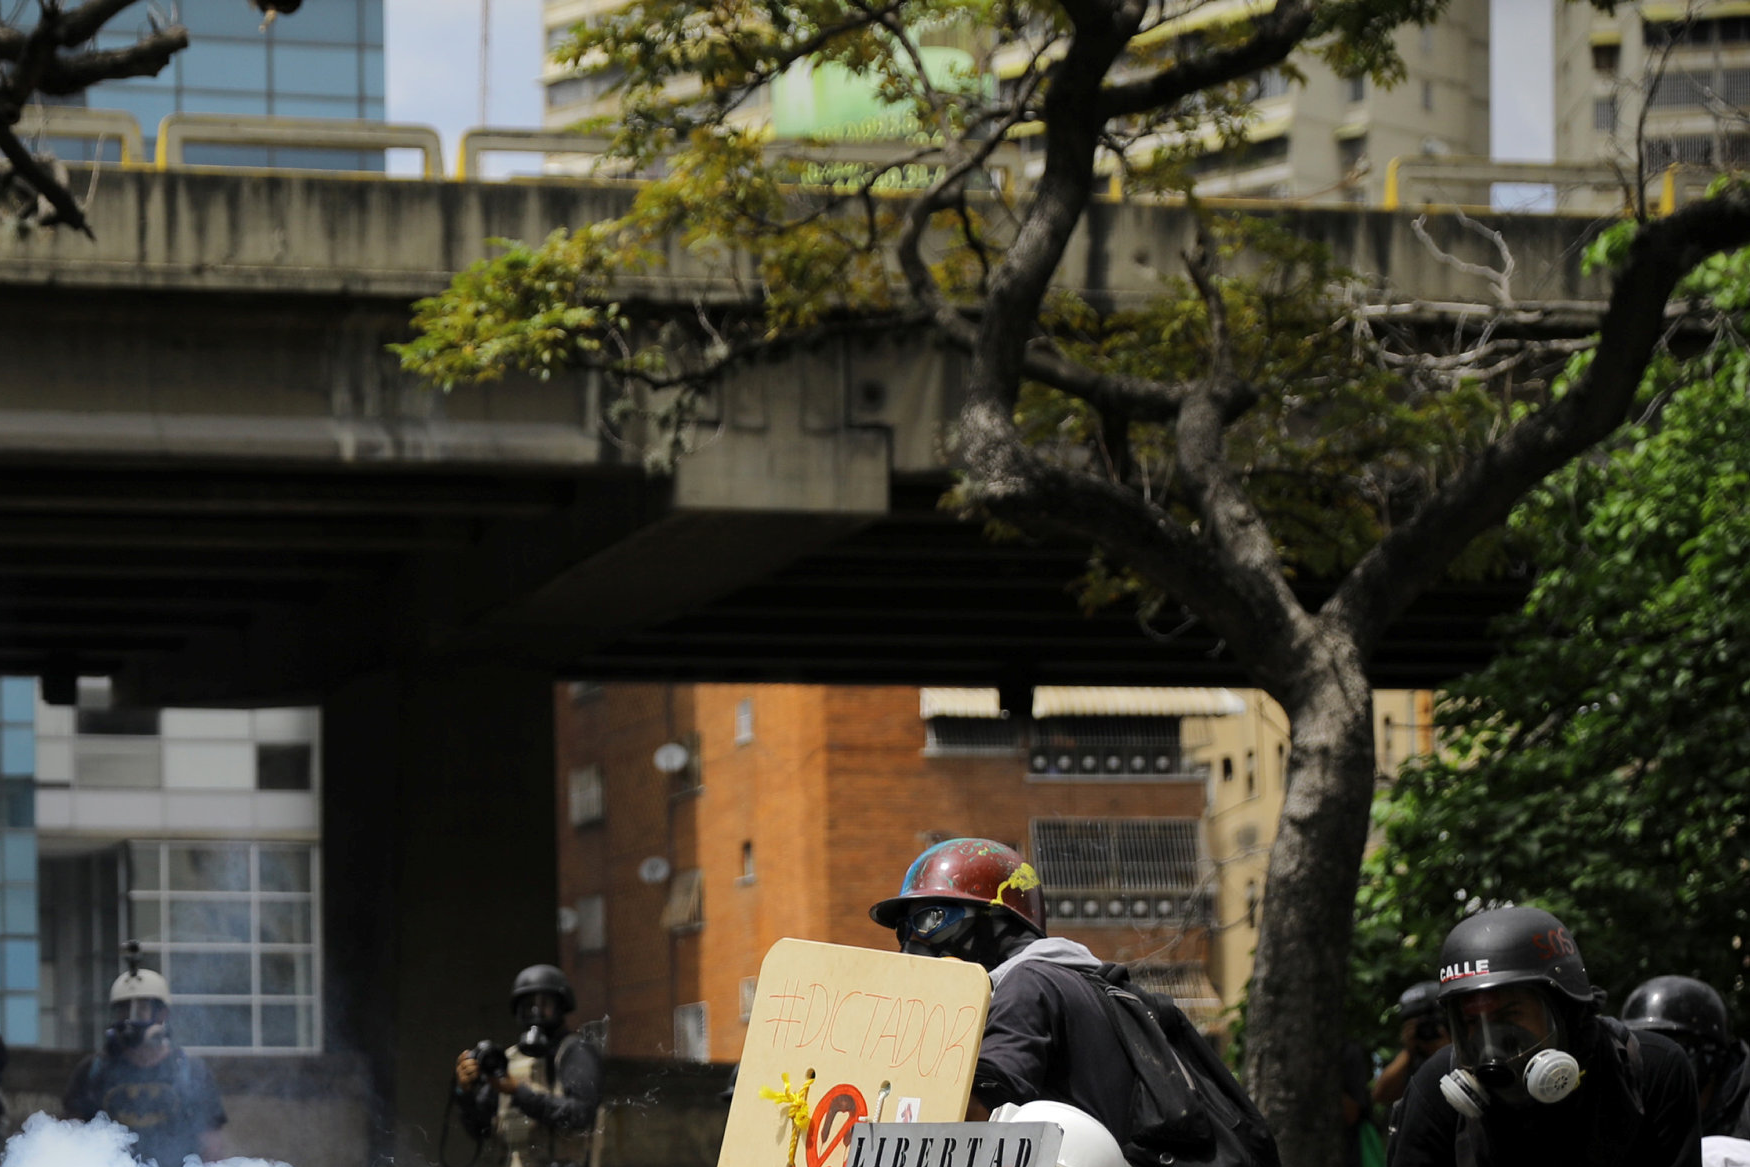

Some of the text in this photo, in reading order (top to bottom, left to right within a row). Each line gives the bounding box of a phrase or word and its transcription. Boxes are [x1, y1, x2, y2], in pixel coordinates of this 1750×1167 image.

[1532, 927, 1575, 960] SOS
[1439, 959, 1490, 982] CALLE
[765, 978, 978, 1086] #DICTADOR
